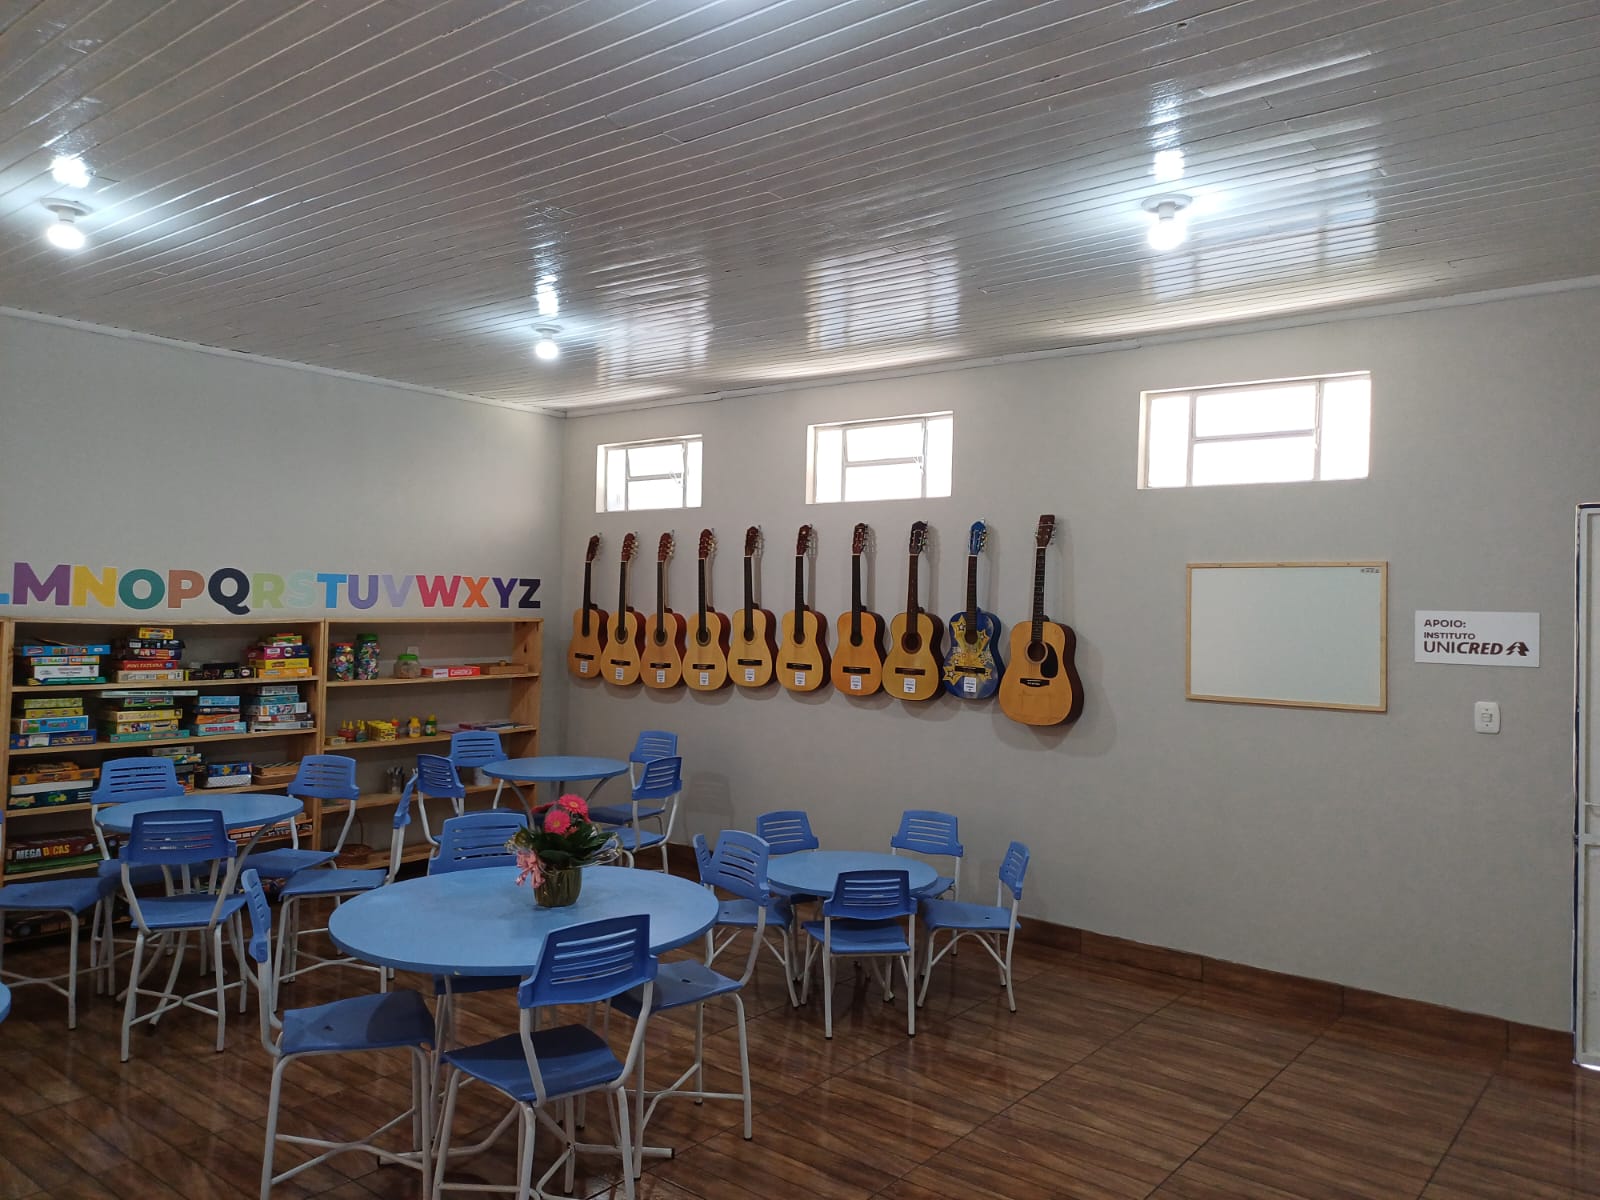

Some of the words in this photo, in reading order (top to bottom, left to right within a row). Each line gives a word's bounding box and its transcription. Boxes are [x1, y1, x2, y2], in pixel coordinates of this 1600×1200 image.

[1424, 619, 1467, 628] APOIO:
[1423, 631, 1476, 640] INSTITUTO
[1424, 641, 1504, 655] UNICRED
[16, 848, 42, 859] MEGA
